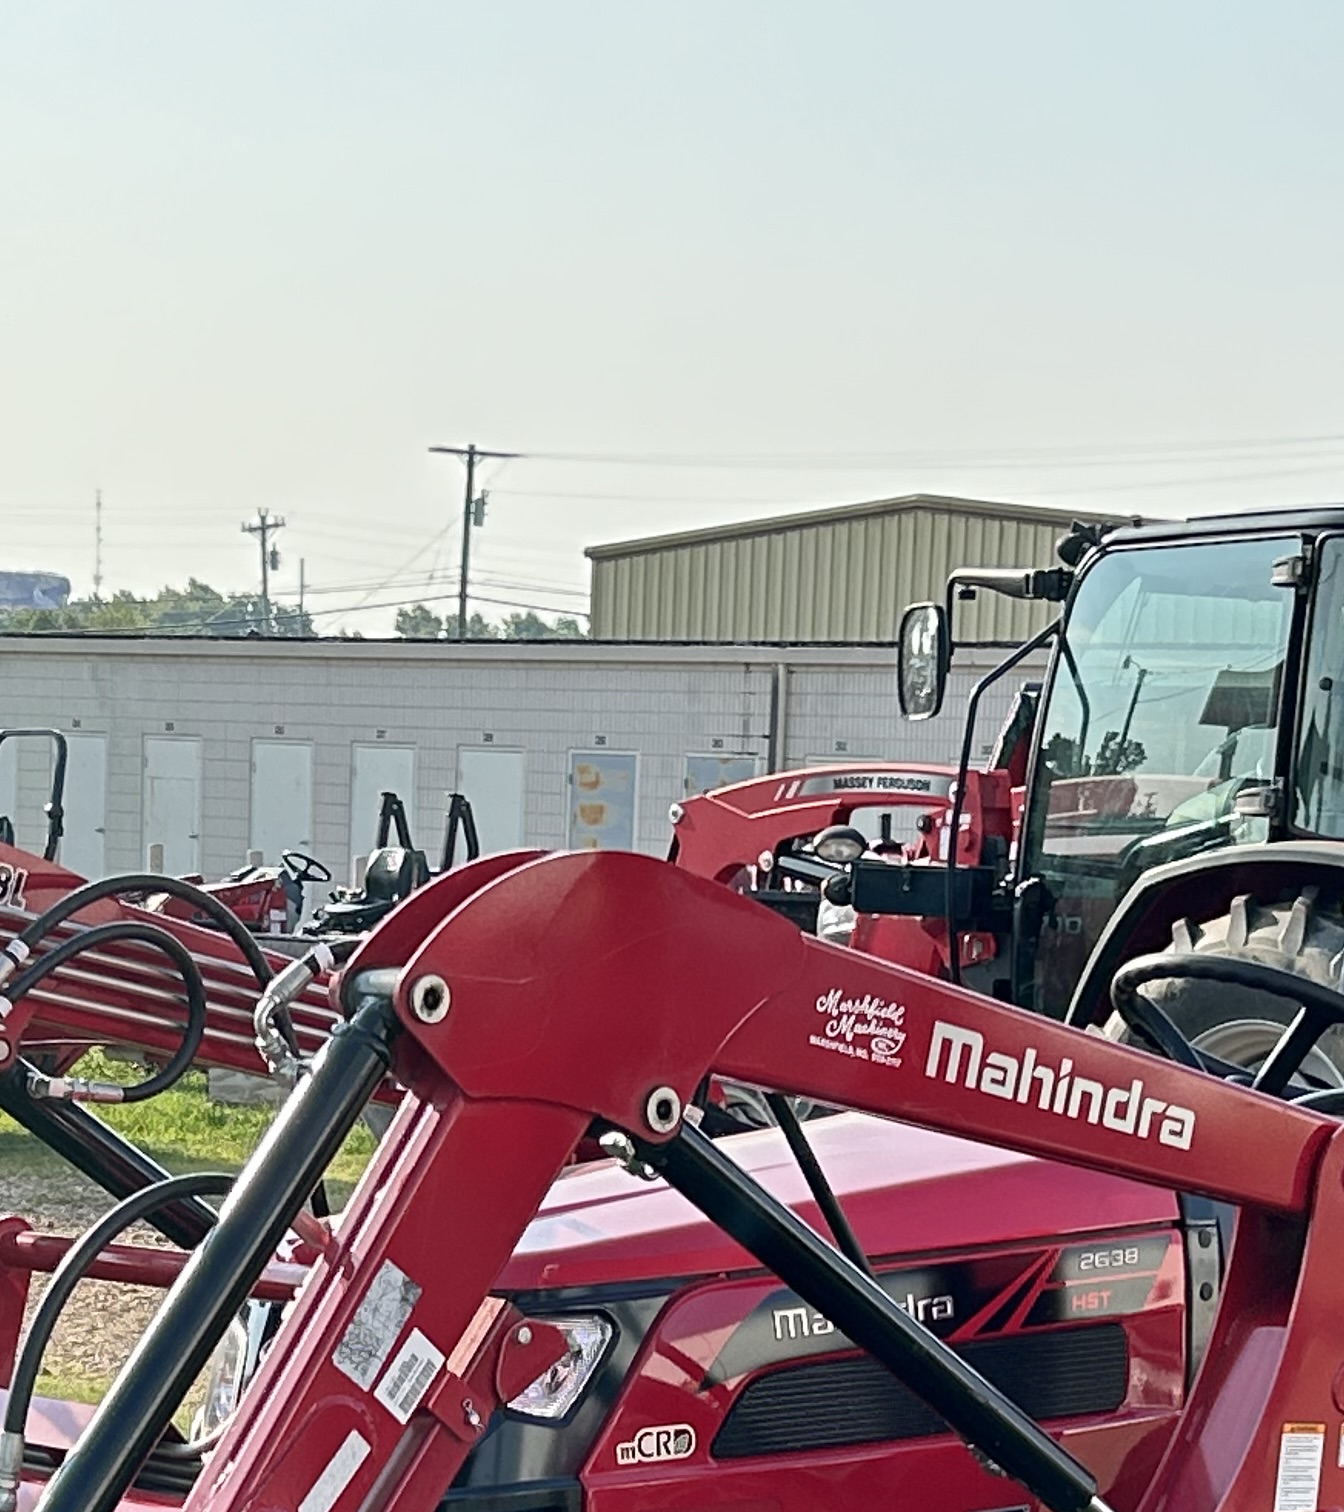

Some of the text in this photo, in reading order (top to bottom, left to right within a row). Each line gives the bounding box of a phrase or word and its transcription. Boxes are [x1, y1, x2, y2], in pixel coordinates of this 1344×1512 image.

[833, 776, 931, 791] MASSEY FERGUSON
[816, 988, 905, 1026] Marshfield
[825, 1014, 907, 1055] Machinery
[925, 1020, 1196, 1151] Mahindra
[1080, 1247, 1138, 1270] 2638
[1071, 1290, 1111, 1312] HST
